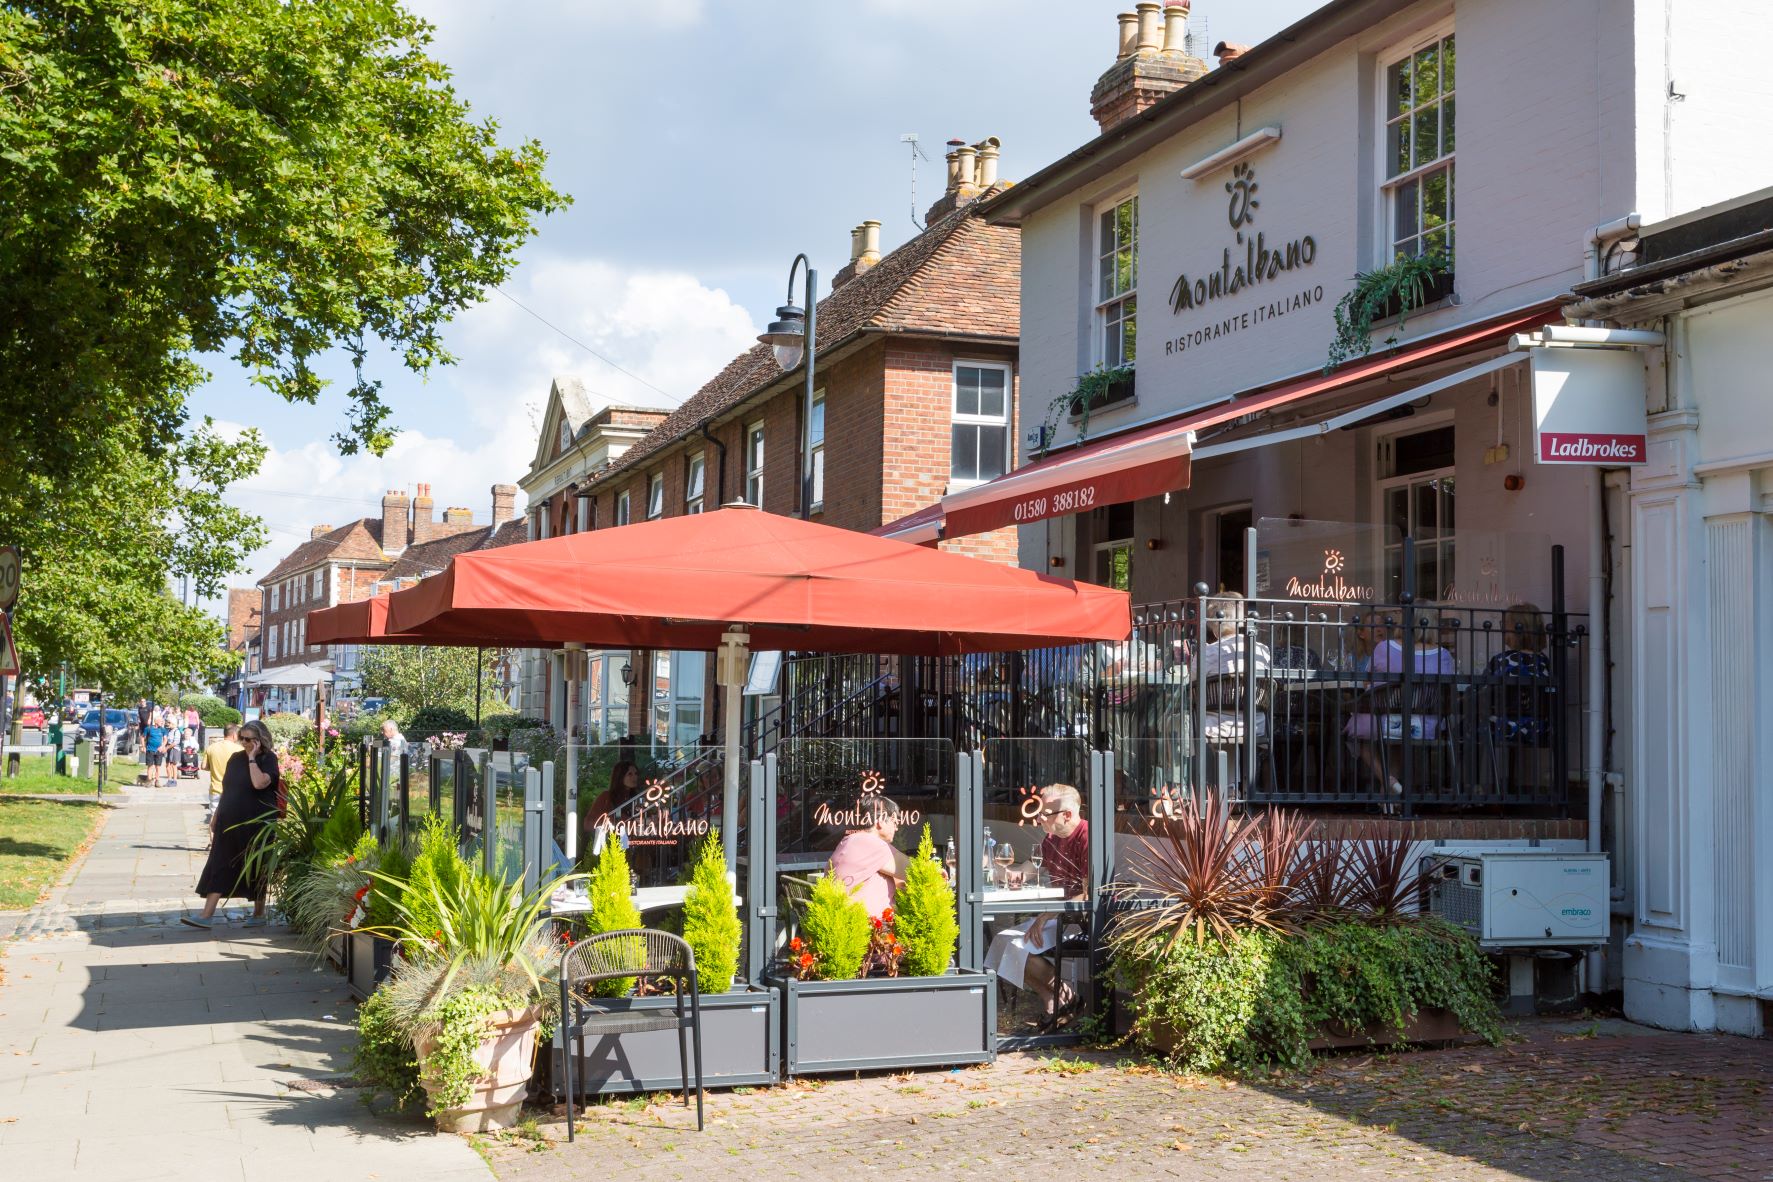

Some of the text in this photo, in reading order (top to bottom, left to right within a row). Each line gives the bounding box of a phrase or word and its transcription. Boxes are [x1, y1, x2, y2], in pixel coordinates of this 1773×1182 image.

[1169, 232, 1316, 315] Montalbano
[1166, 285, 1323, 356] RISTORANTE ITALIANO
[1550, 437, 1636, 457] Ladbrokes
[1014, 486, 1095, 520] 01580 388182
[1286, 574, 1374, 601] Montalbano
[593, 808, 708, 838] Montalbano
[814, 799, 920, 826] Montalbano
[1561, 908, 1591, 916] embraco
